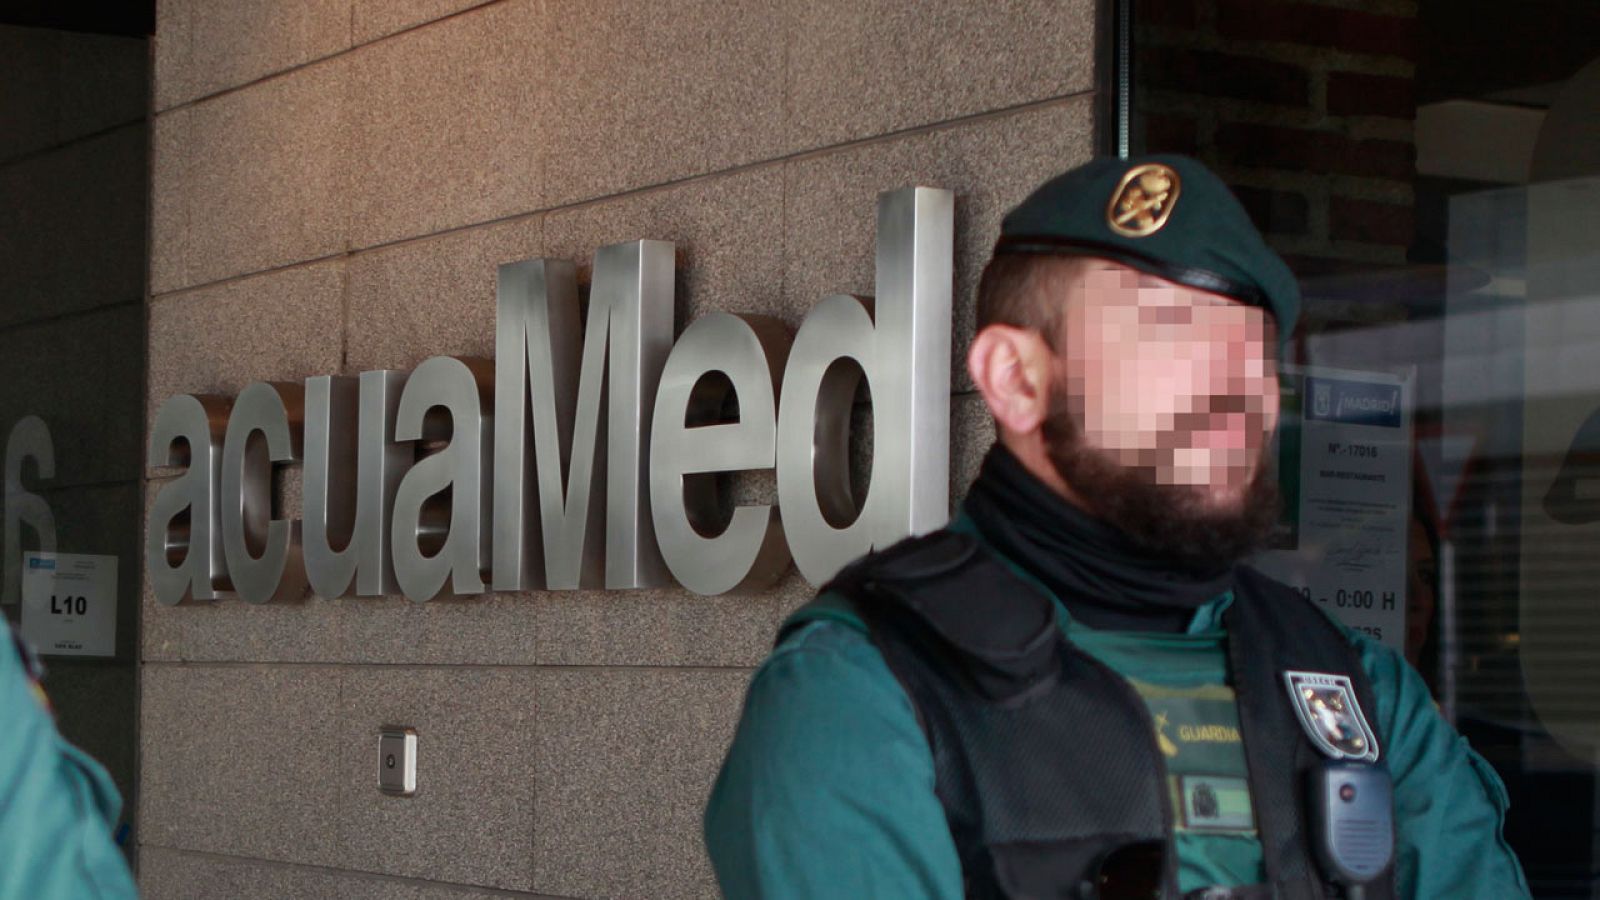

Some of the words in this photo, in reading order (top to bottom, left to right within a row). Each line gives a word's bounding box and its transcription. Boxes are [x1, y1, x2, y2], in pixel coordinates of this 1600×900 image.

[148, 186, 955, 605] acuaMed
[51, 594, 87, 615] L10
[1336, 589, 1374, 609] 0:00
[1382, 591, 1396, 610] H
[1179, 724, 1241, 742] GUARDIA
